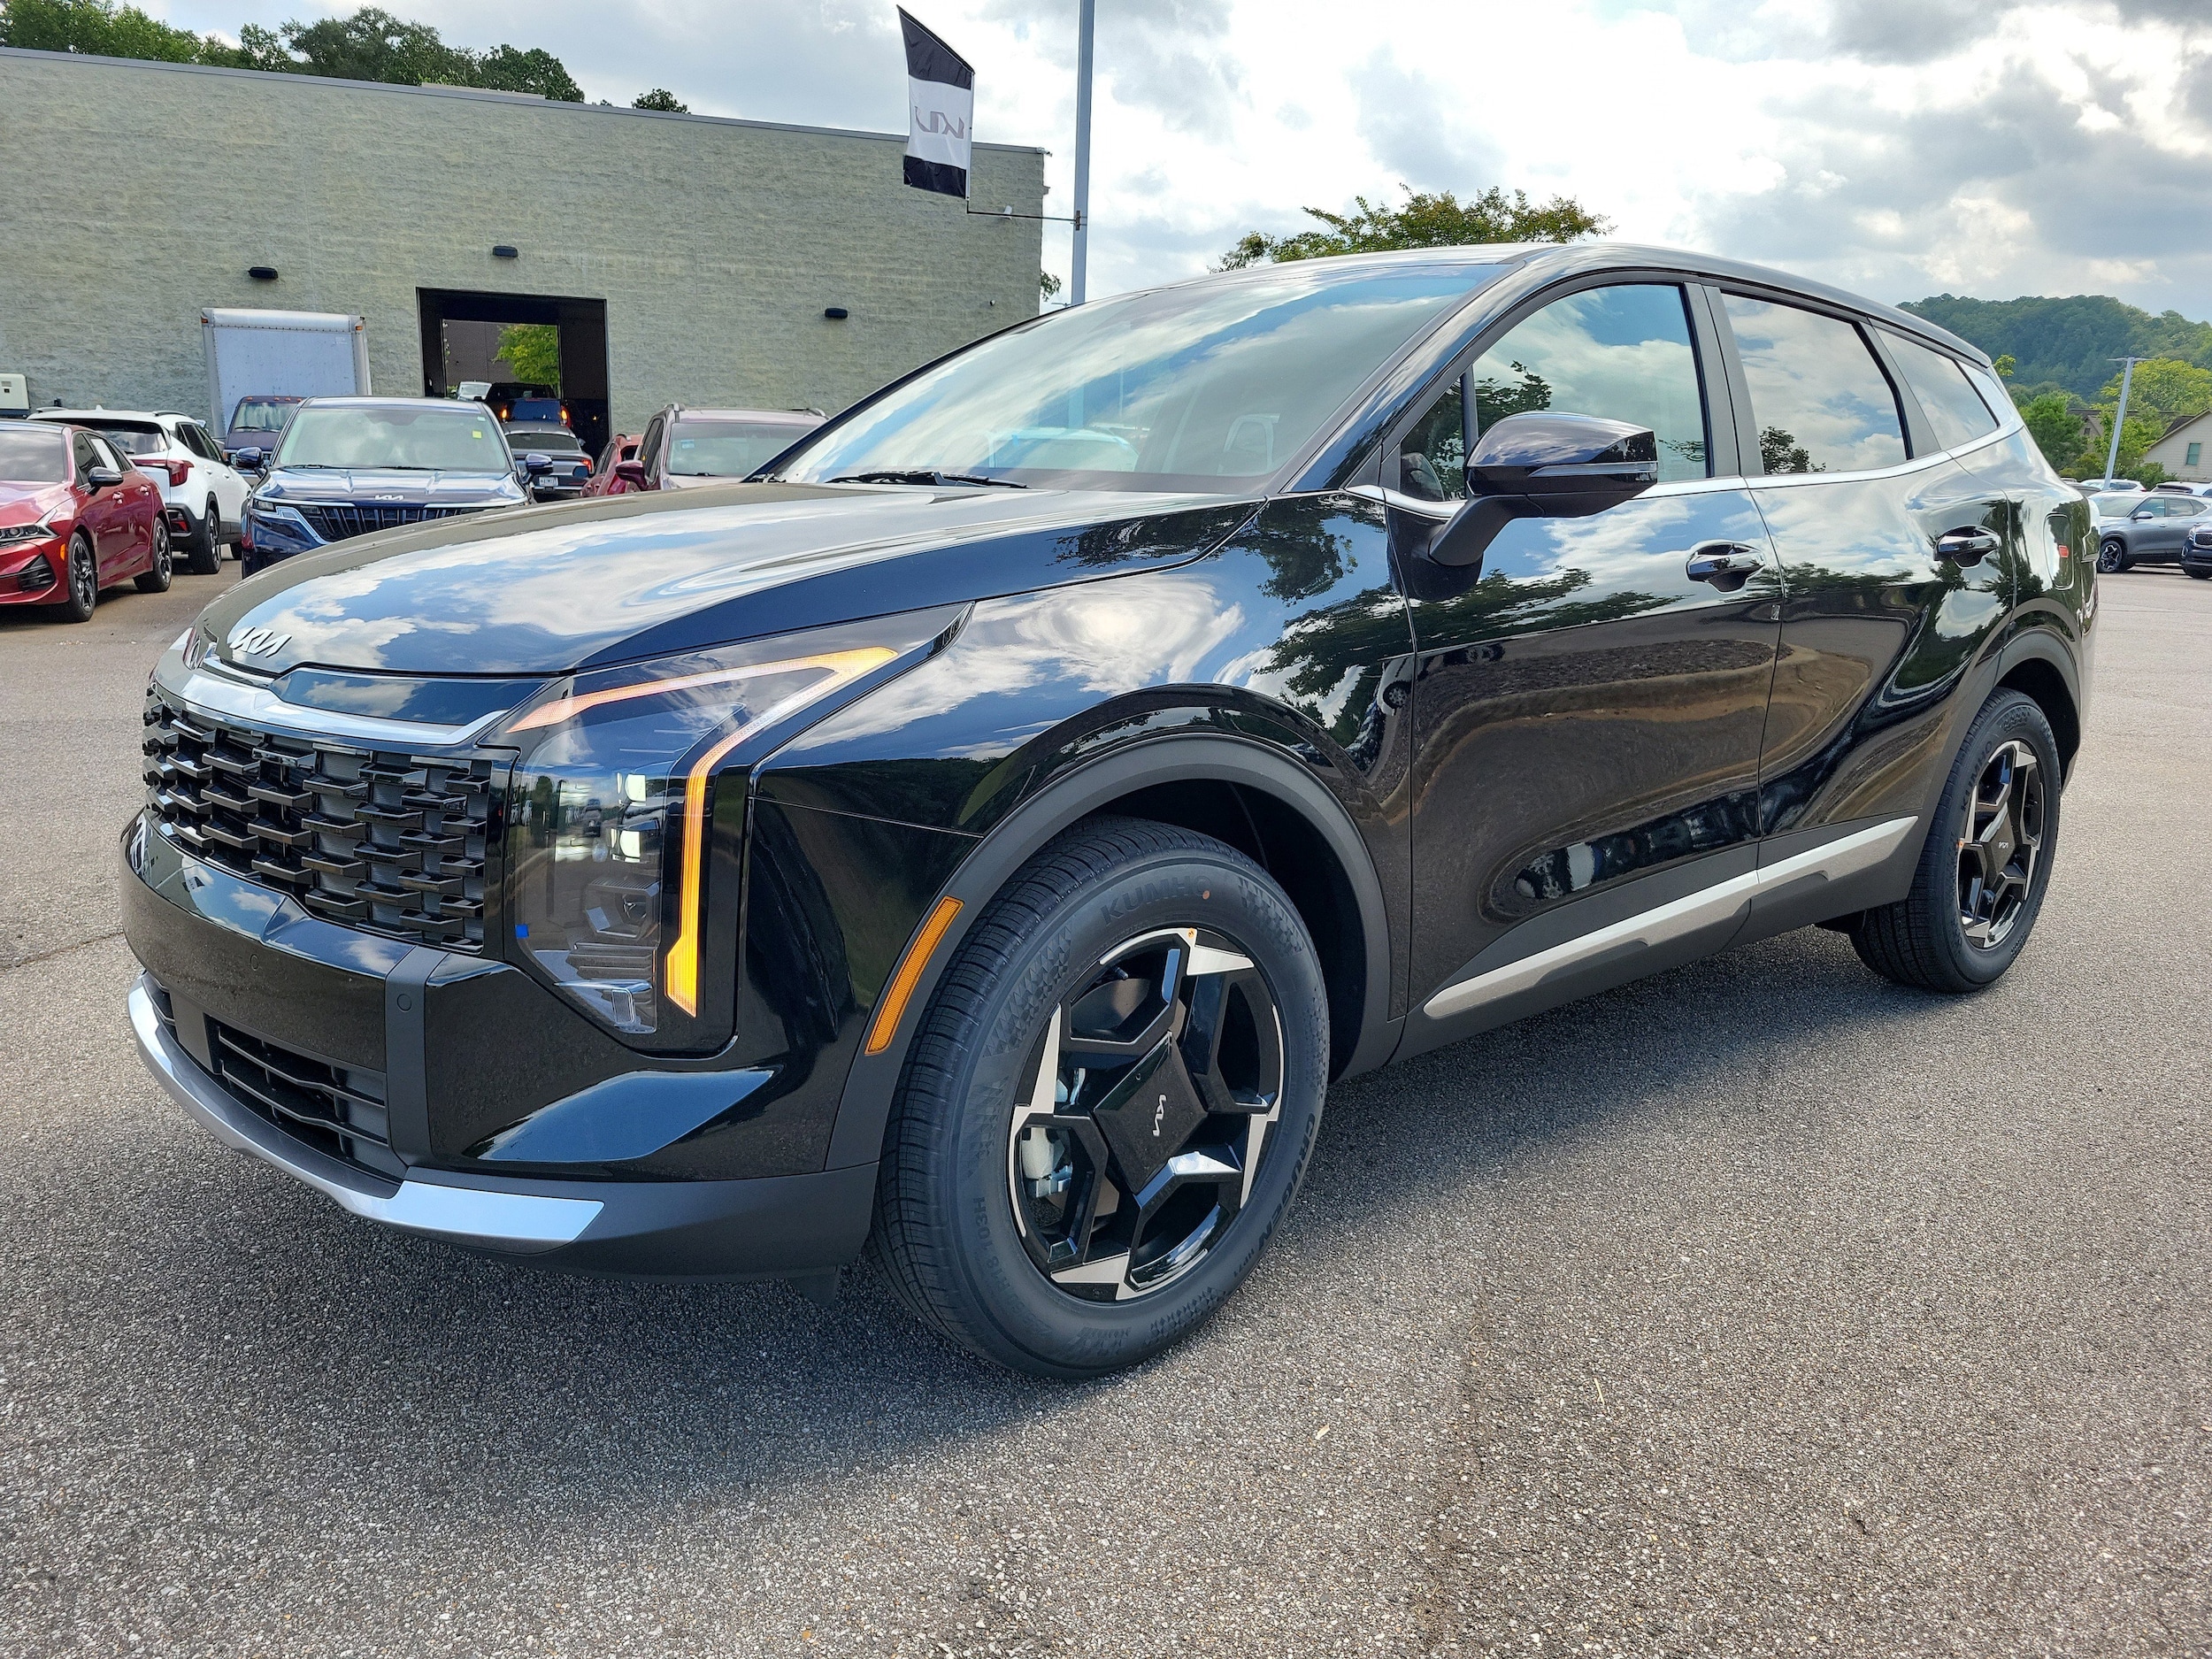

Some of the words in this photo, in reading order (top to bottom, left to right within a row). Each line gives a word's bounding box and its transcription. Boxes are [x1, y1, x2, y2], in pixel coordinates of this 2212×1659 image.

[229, 626, 293, 658] KIA
[1961, 741, 1993, 811] KUMHO
[1101, 875, 1212, 926] KUMHO
[1152, 1094, 1167, 1137] KIA
[1258, 1112, 1316, 1251] CRUGEN
[973, 1196, 992, 1251] 103H
